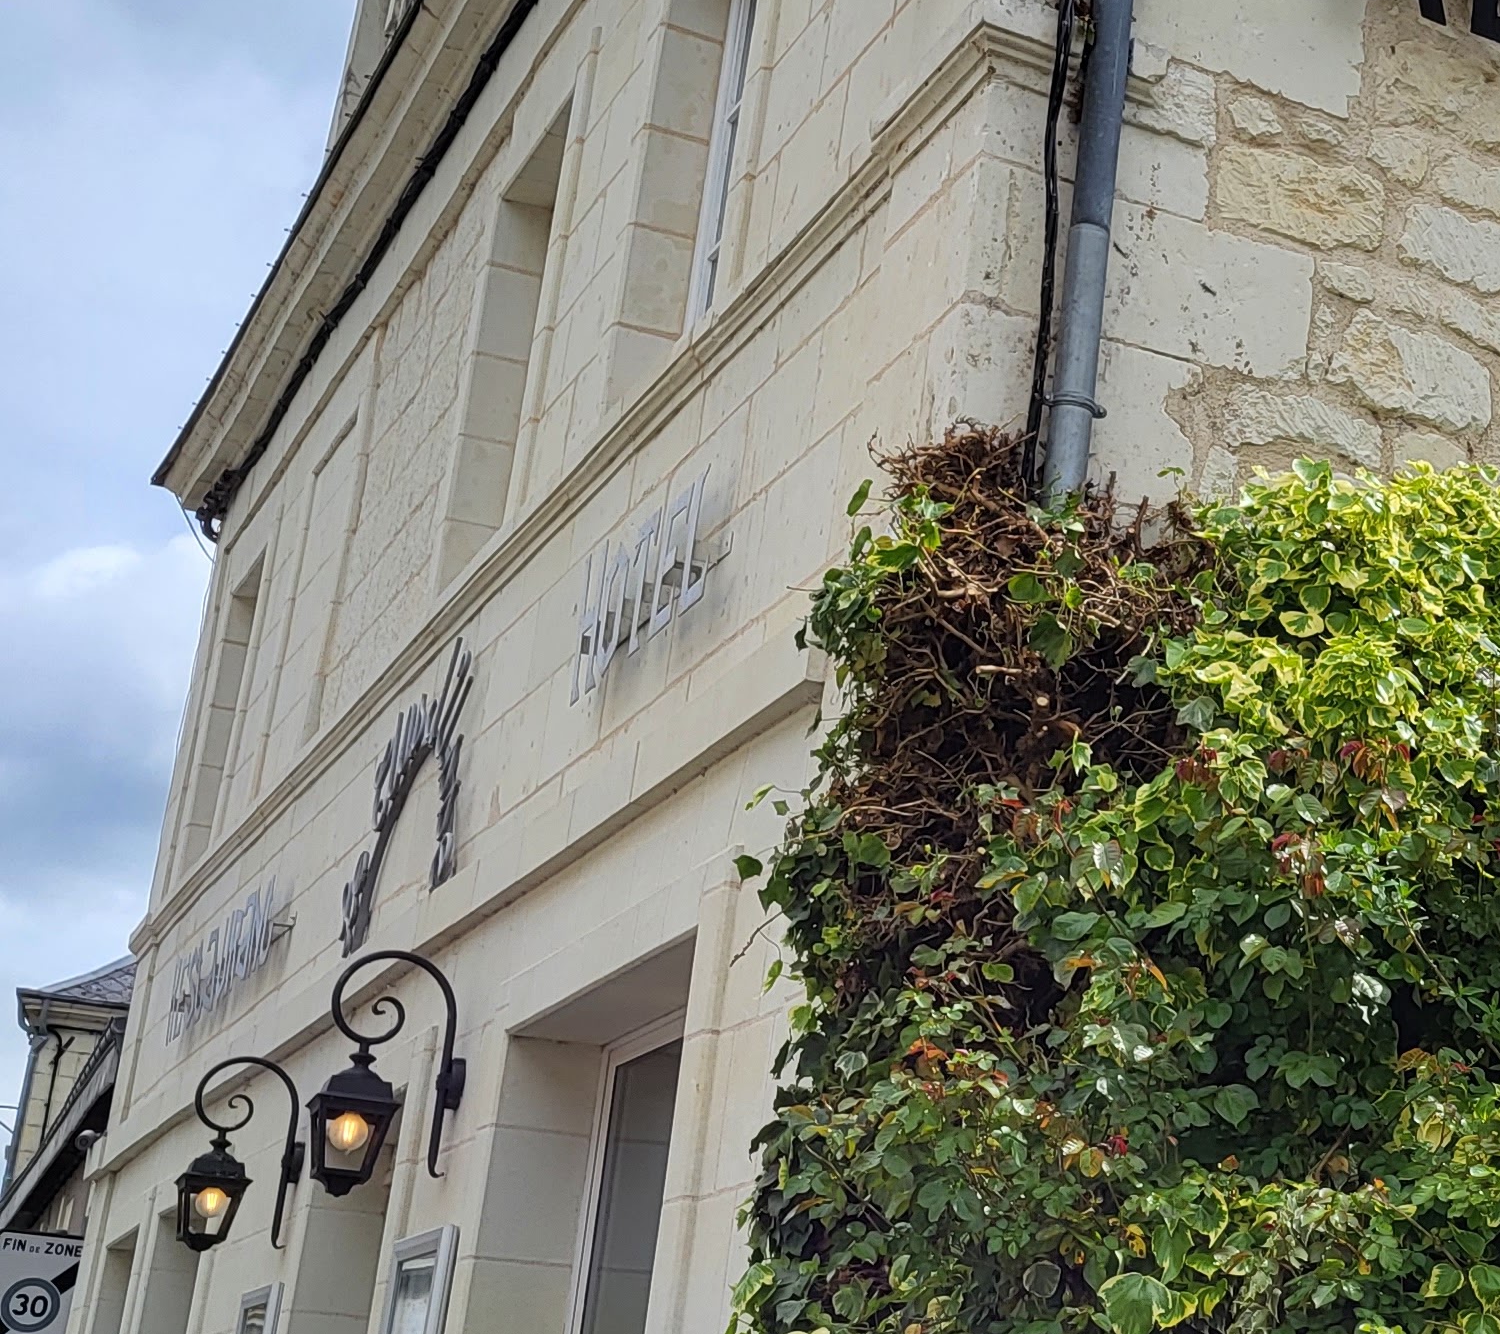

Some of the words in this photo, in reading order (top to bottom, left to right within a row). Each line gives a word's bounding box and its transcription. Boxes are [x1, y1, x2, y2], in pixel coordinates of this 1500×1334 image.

[2, 1237, 28, 1252] FIN
[44, 1241, 83, 1258] ZONE
[11, 1293, 49, 1318] 30
